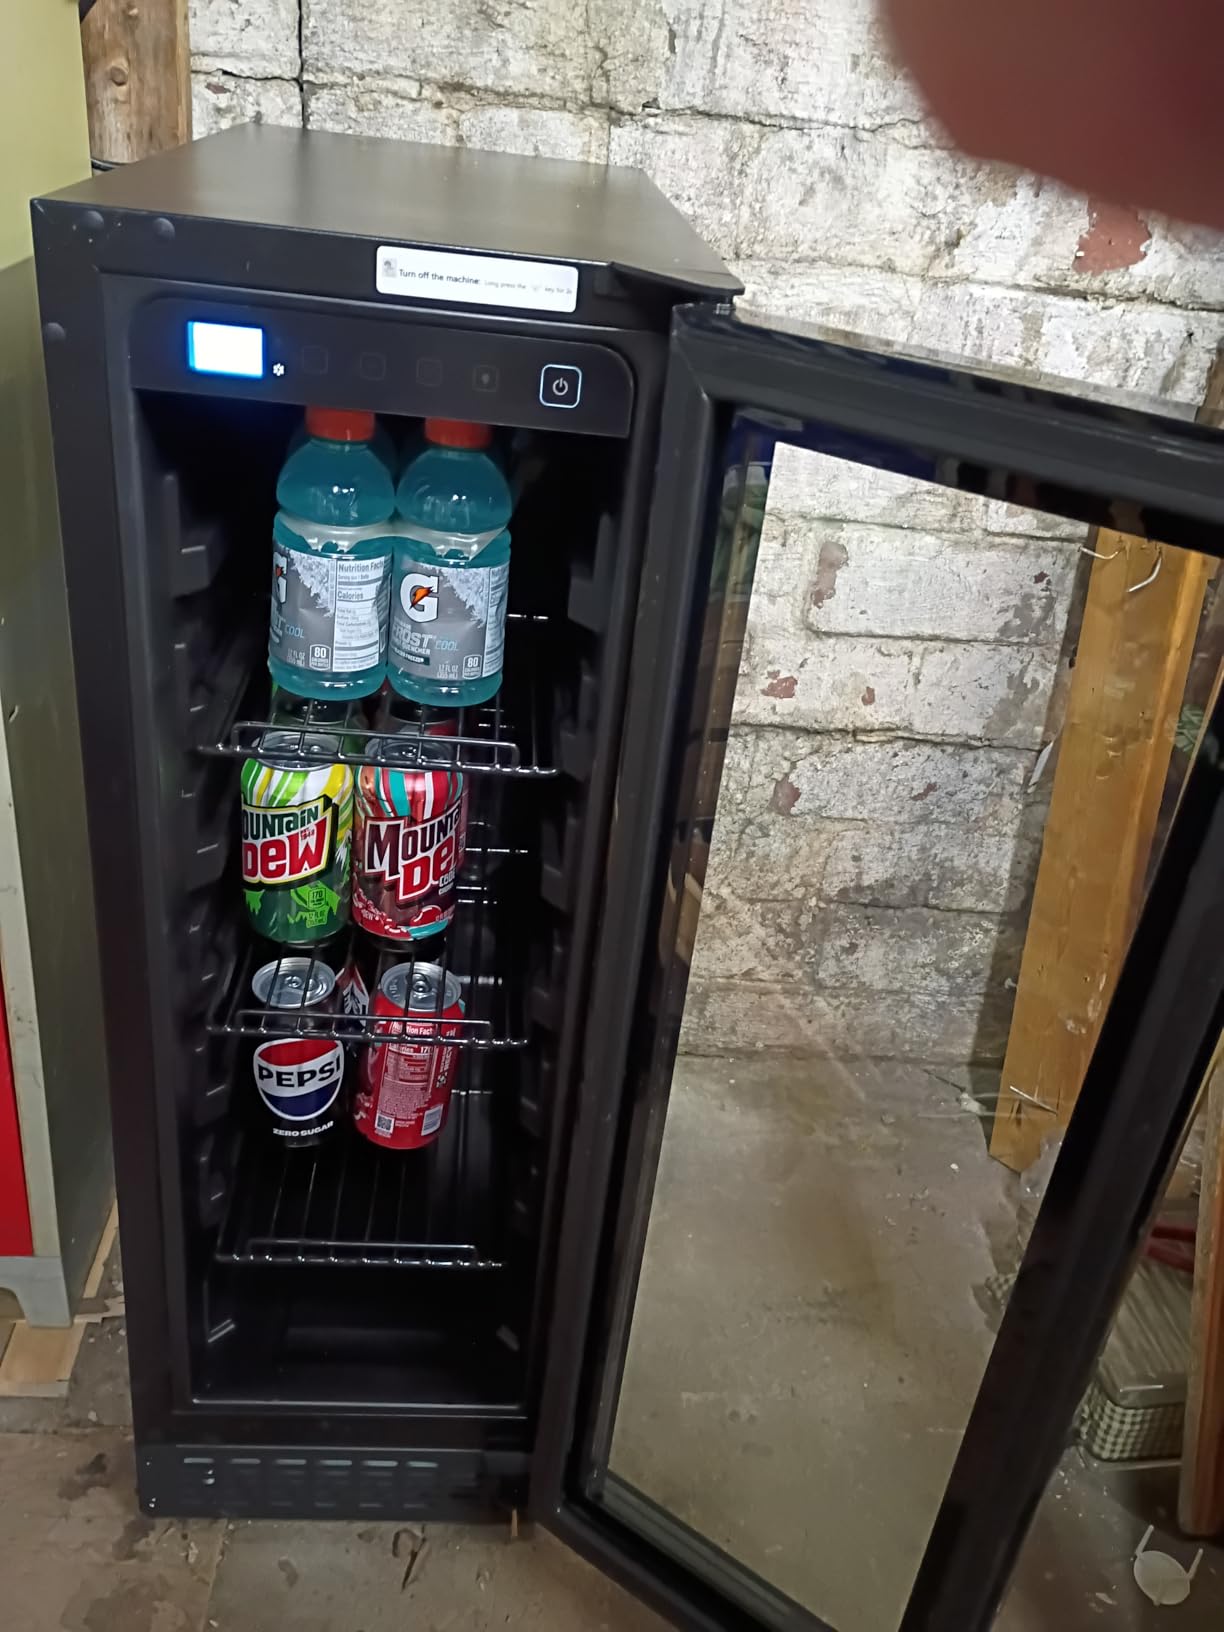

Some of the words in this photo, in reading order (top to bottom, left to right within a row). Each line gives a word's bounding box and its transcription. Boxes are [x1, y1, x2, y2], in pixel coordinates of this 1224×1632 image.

[399, 268, 416, 278] Turn
[418, 271, 430, 280] off
[432, 273, 444, 282] the
[338, 562, 370, 573] Nutrition
[338, 590, 364, 600] Calories
[400, 573, 439, 623] G
[285, 624, 305, 639] COOL
[392, 624, 433, 648] FROST
[436, 640, 459, 651] COOL
[314, 646, 327, 659] 80
[467, 657, 479, 668] 80
[402, 835, 455, 896] De
[312, 890, 323, 899] 170
[257, 1054, 341, 1088] PEPSI
[272, 1127, 300, 1137] ZERO
[300, 1120, 334, 1137] SUGAR
